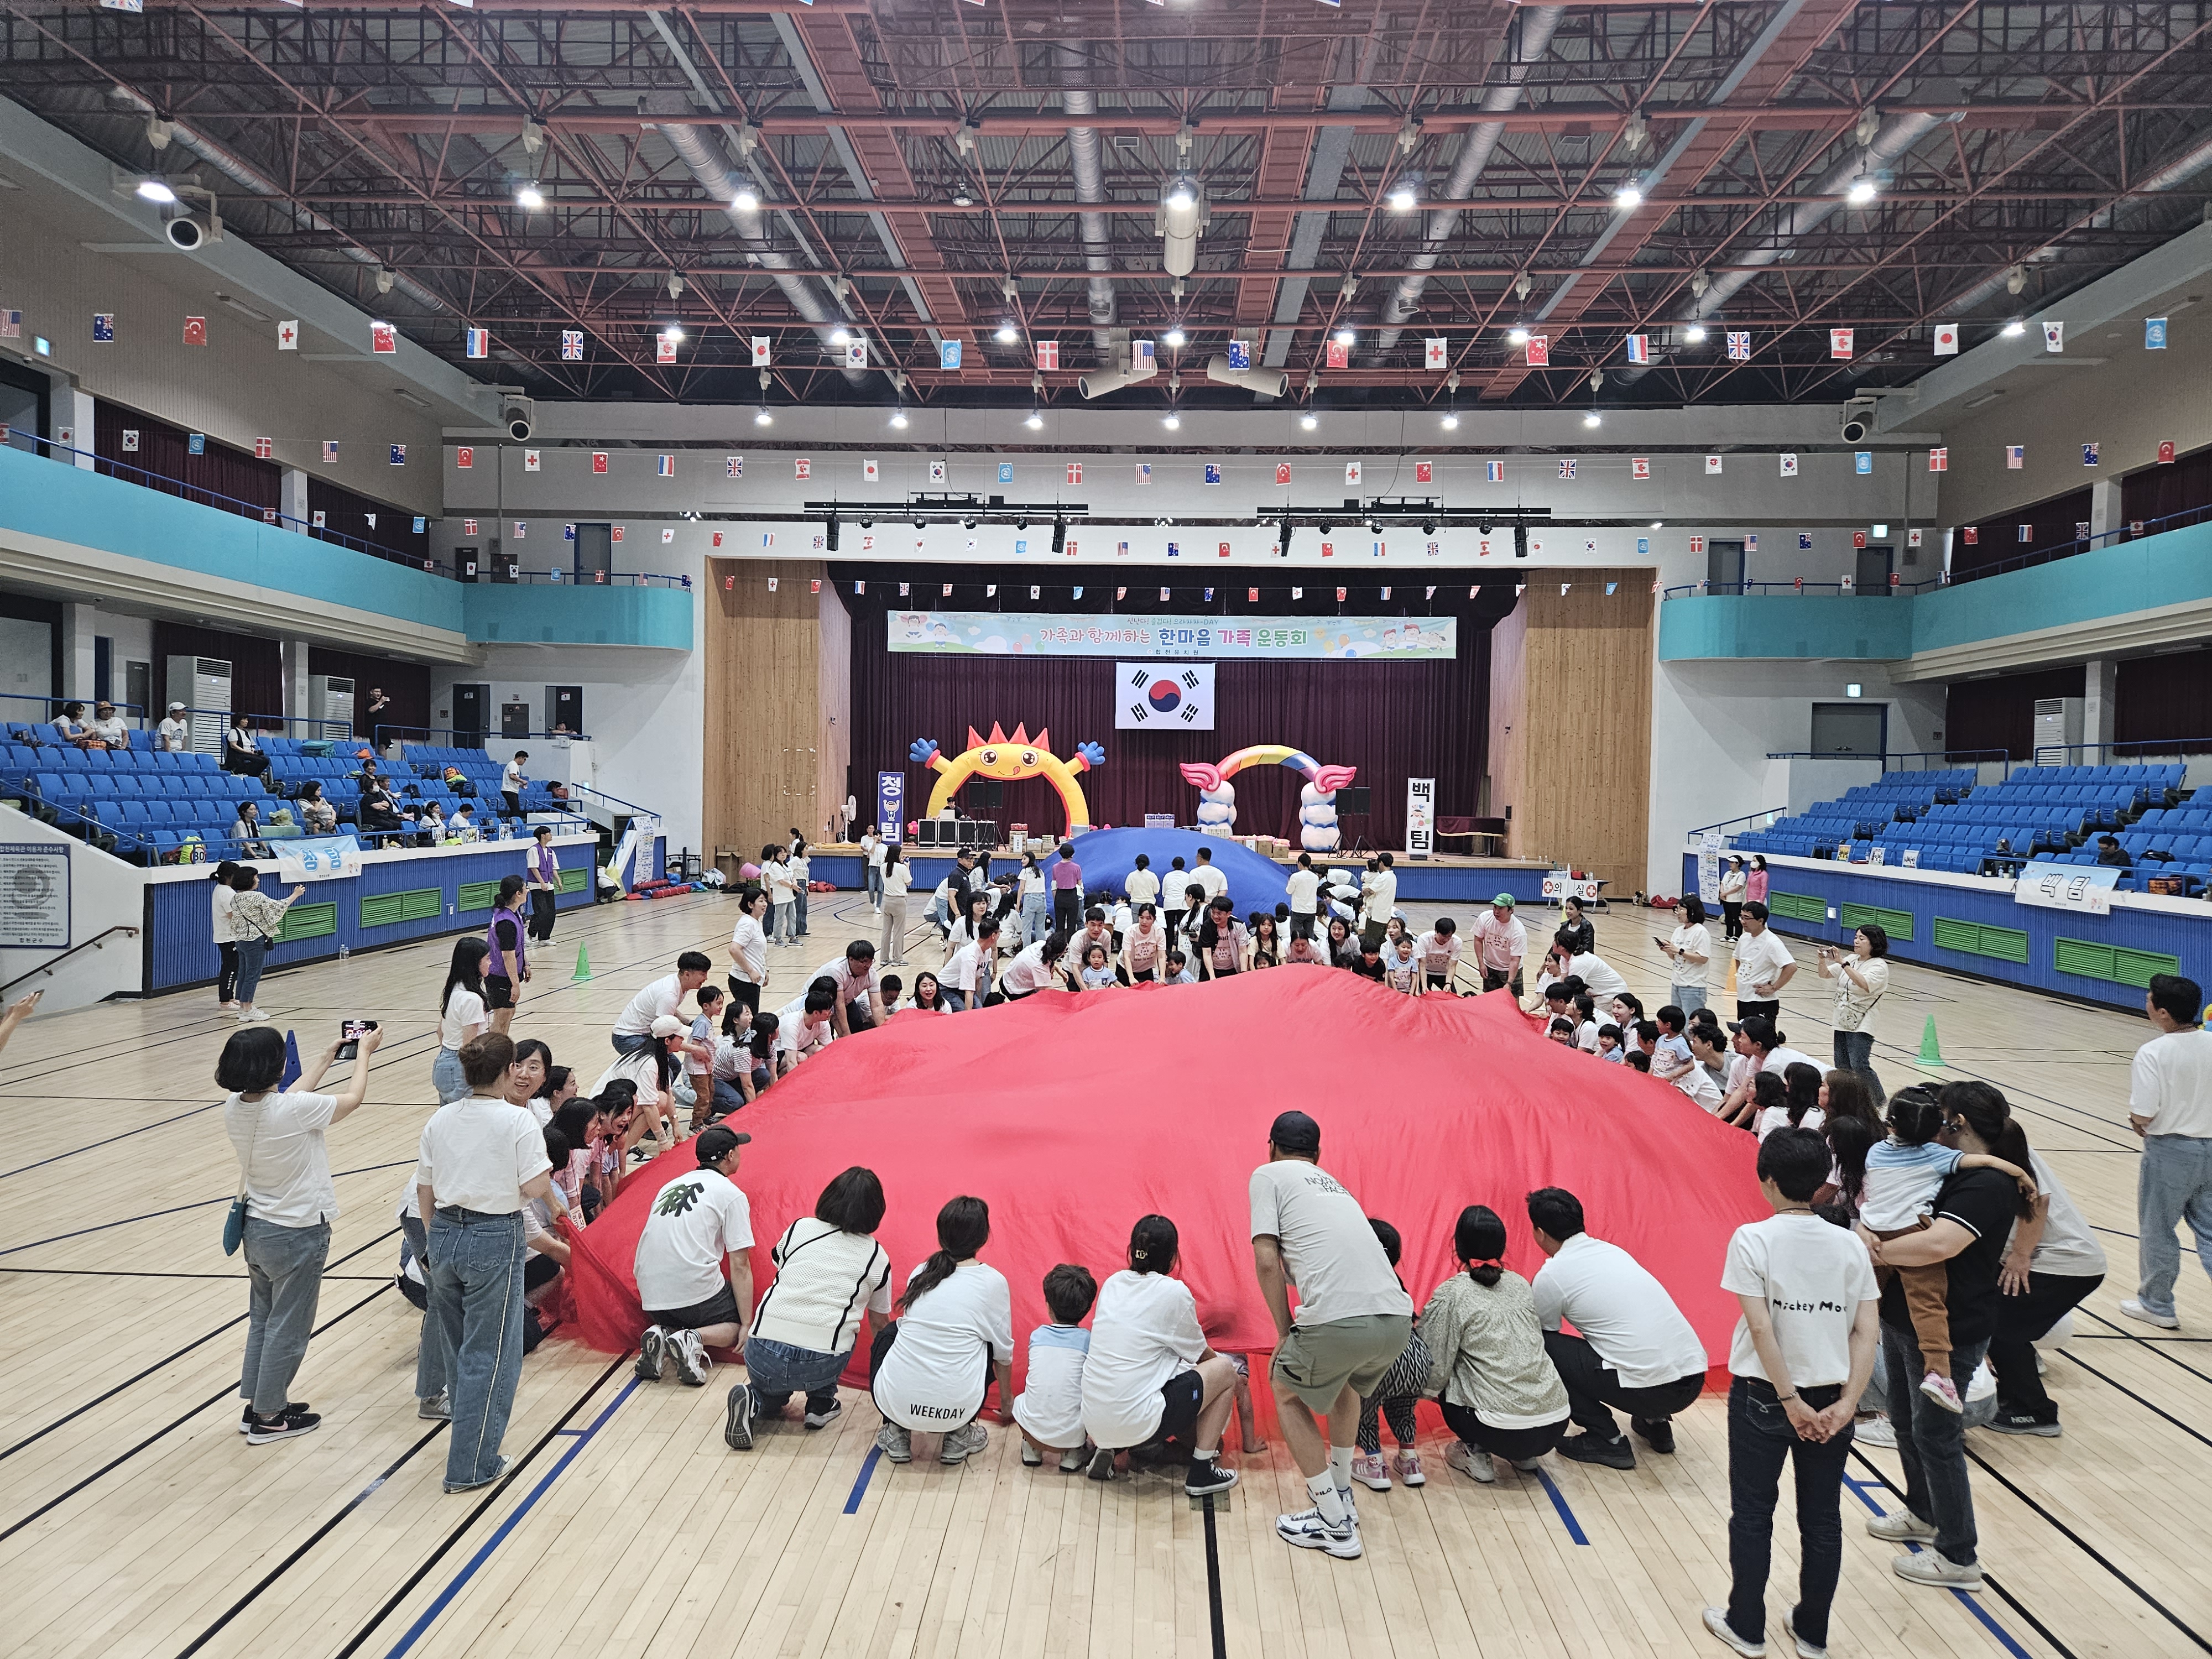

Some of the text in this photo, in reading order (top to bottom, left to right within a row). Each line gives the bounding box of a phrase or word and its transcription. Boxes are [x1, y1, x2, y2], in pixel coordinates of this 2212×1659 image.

[1041, 628, 1084, 643] 가족과
[1159, 628, 1211, 646] 한마음
[1218, 630, 1250, 646] 가족
[1258, 629, 1306, 647] 운동회
[1772, 1298, 1814, 1313] Mickey
[910, 1404, 966, 1420] WEEKDAY
[2011, 1416, 2036, 1424] HOKA
[1315, 1487, 1332, 1496] FILA
